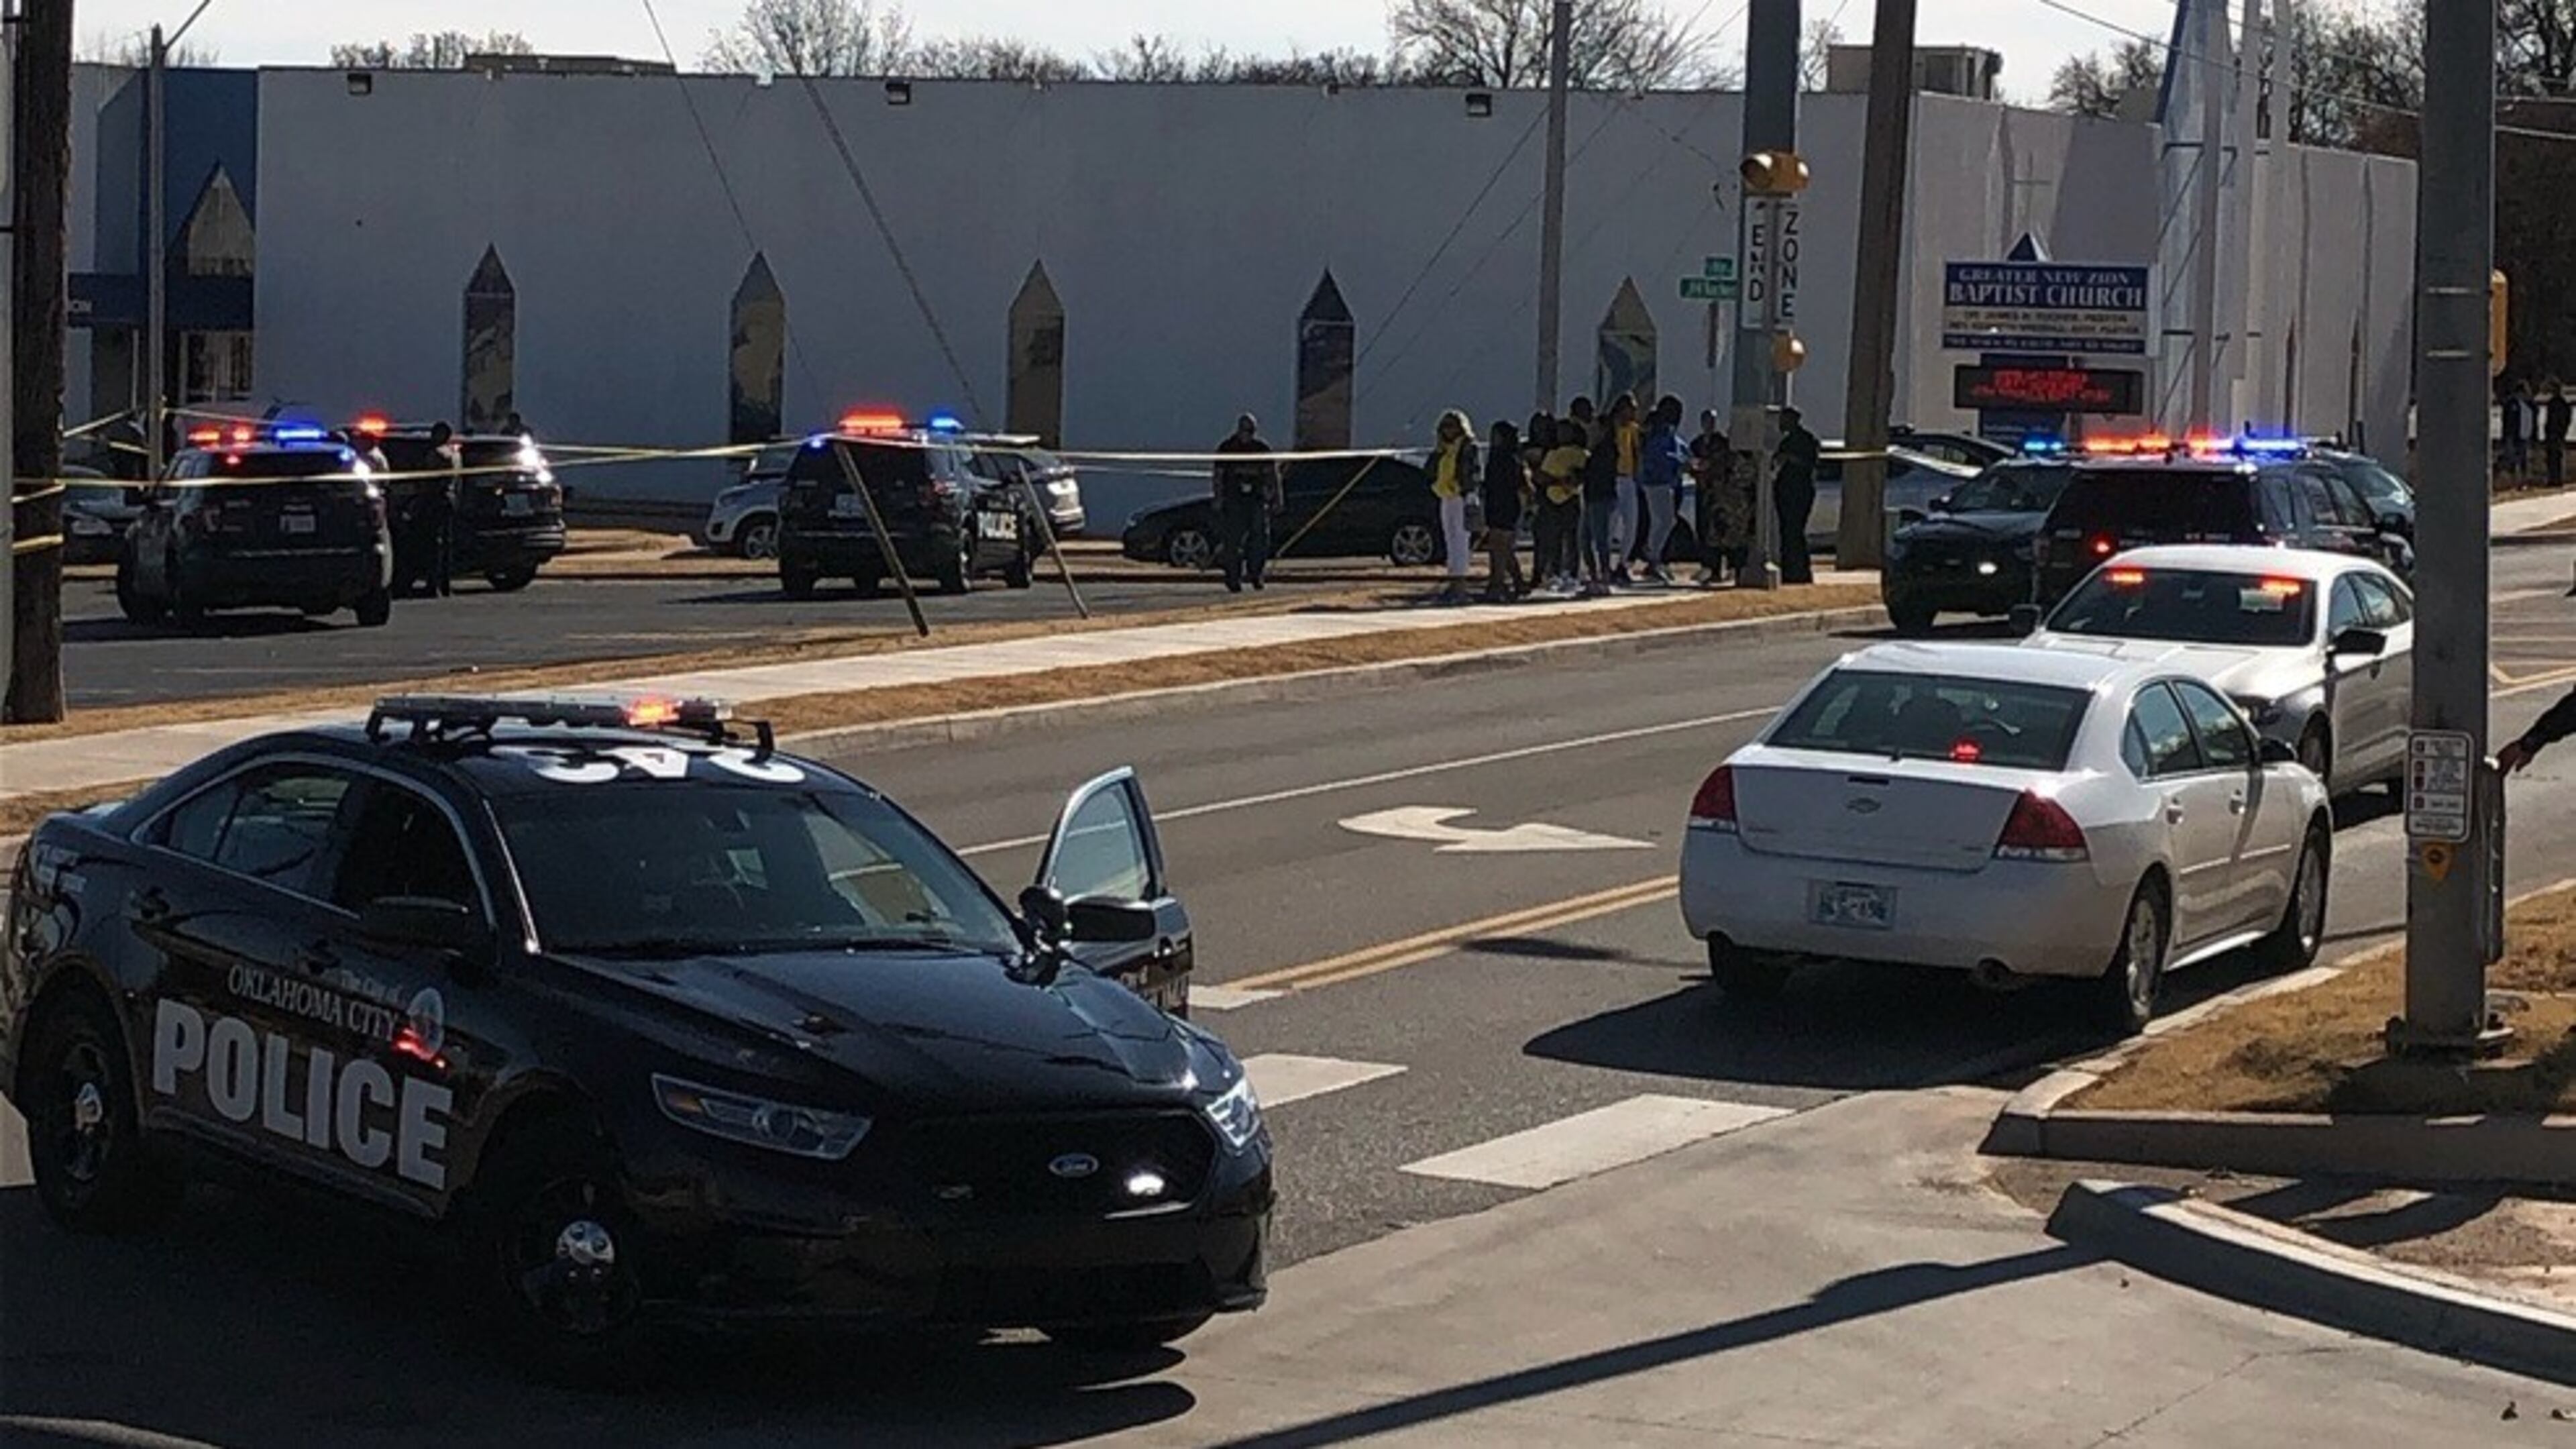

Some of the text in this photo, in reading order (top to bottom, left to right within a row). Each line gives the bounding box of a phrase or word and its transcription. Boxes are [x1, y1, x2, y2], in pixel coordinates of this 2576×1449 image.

[1748, 224, 1765, 302] END
[1782, 211, 1799, 317] ZONE
[1949, 282, 2142, 307] BAPTIST CHURCH
[1959, 268, 2129, 285] GREATER NEW ZION
[227, 963, 400, 1042] OKLAHOMA CITY
[153, 998, 453, 1191] POLICE
